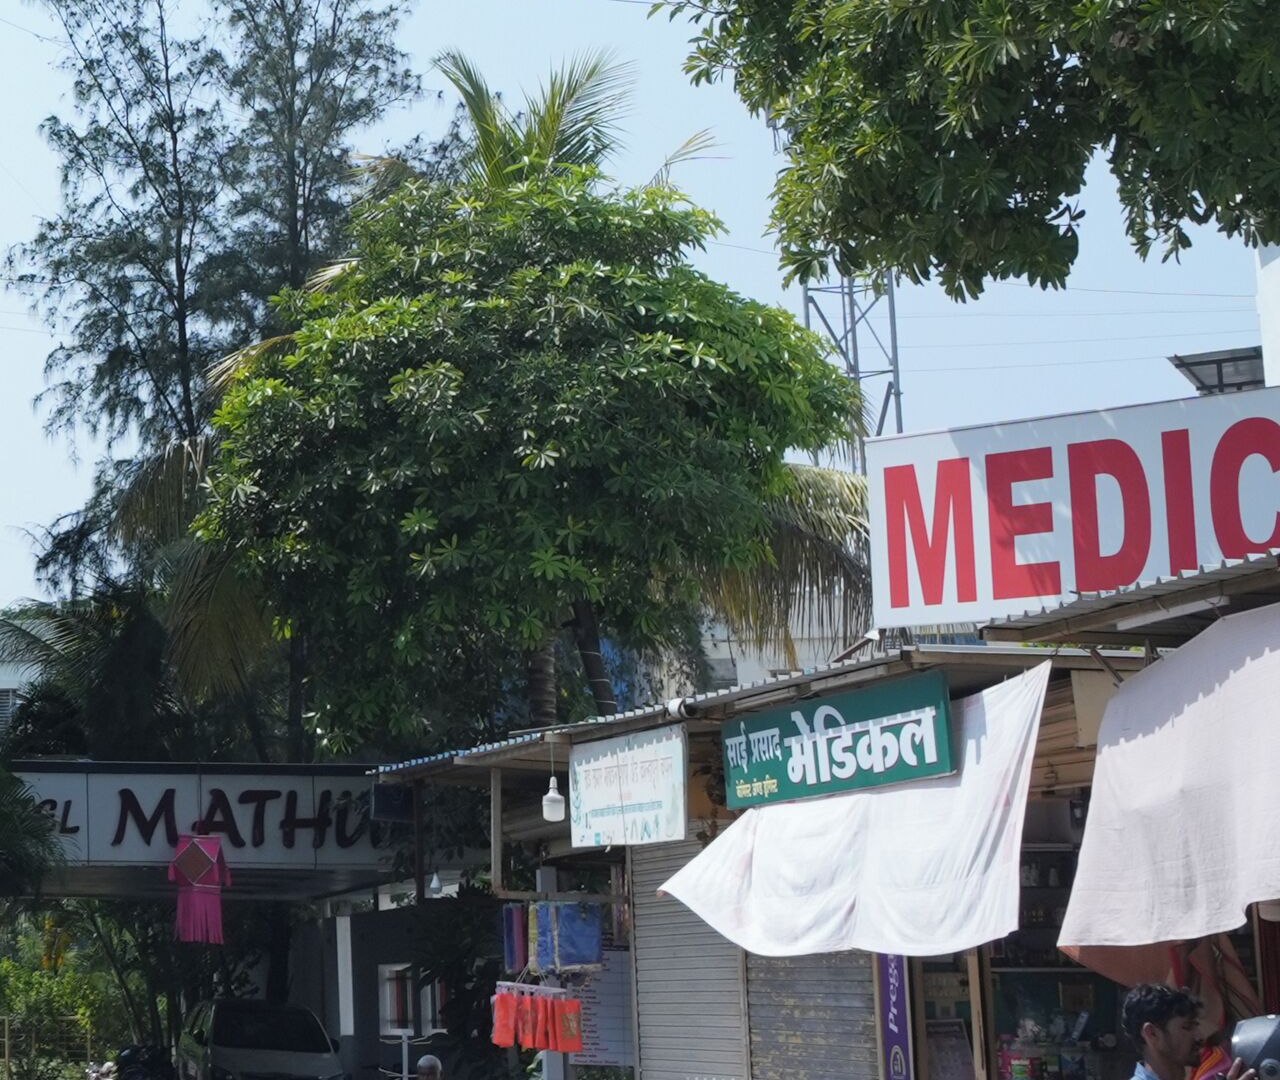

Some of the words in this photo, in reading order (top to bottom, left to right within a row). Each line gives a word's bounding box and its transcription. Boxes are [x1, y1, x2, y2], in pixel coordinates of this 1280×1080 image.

[725, 721, 750, 773] साई
[748, 727, 783, 764] प्रसाद
[783, 704, 938, 786] मेडिकल
